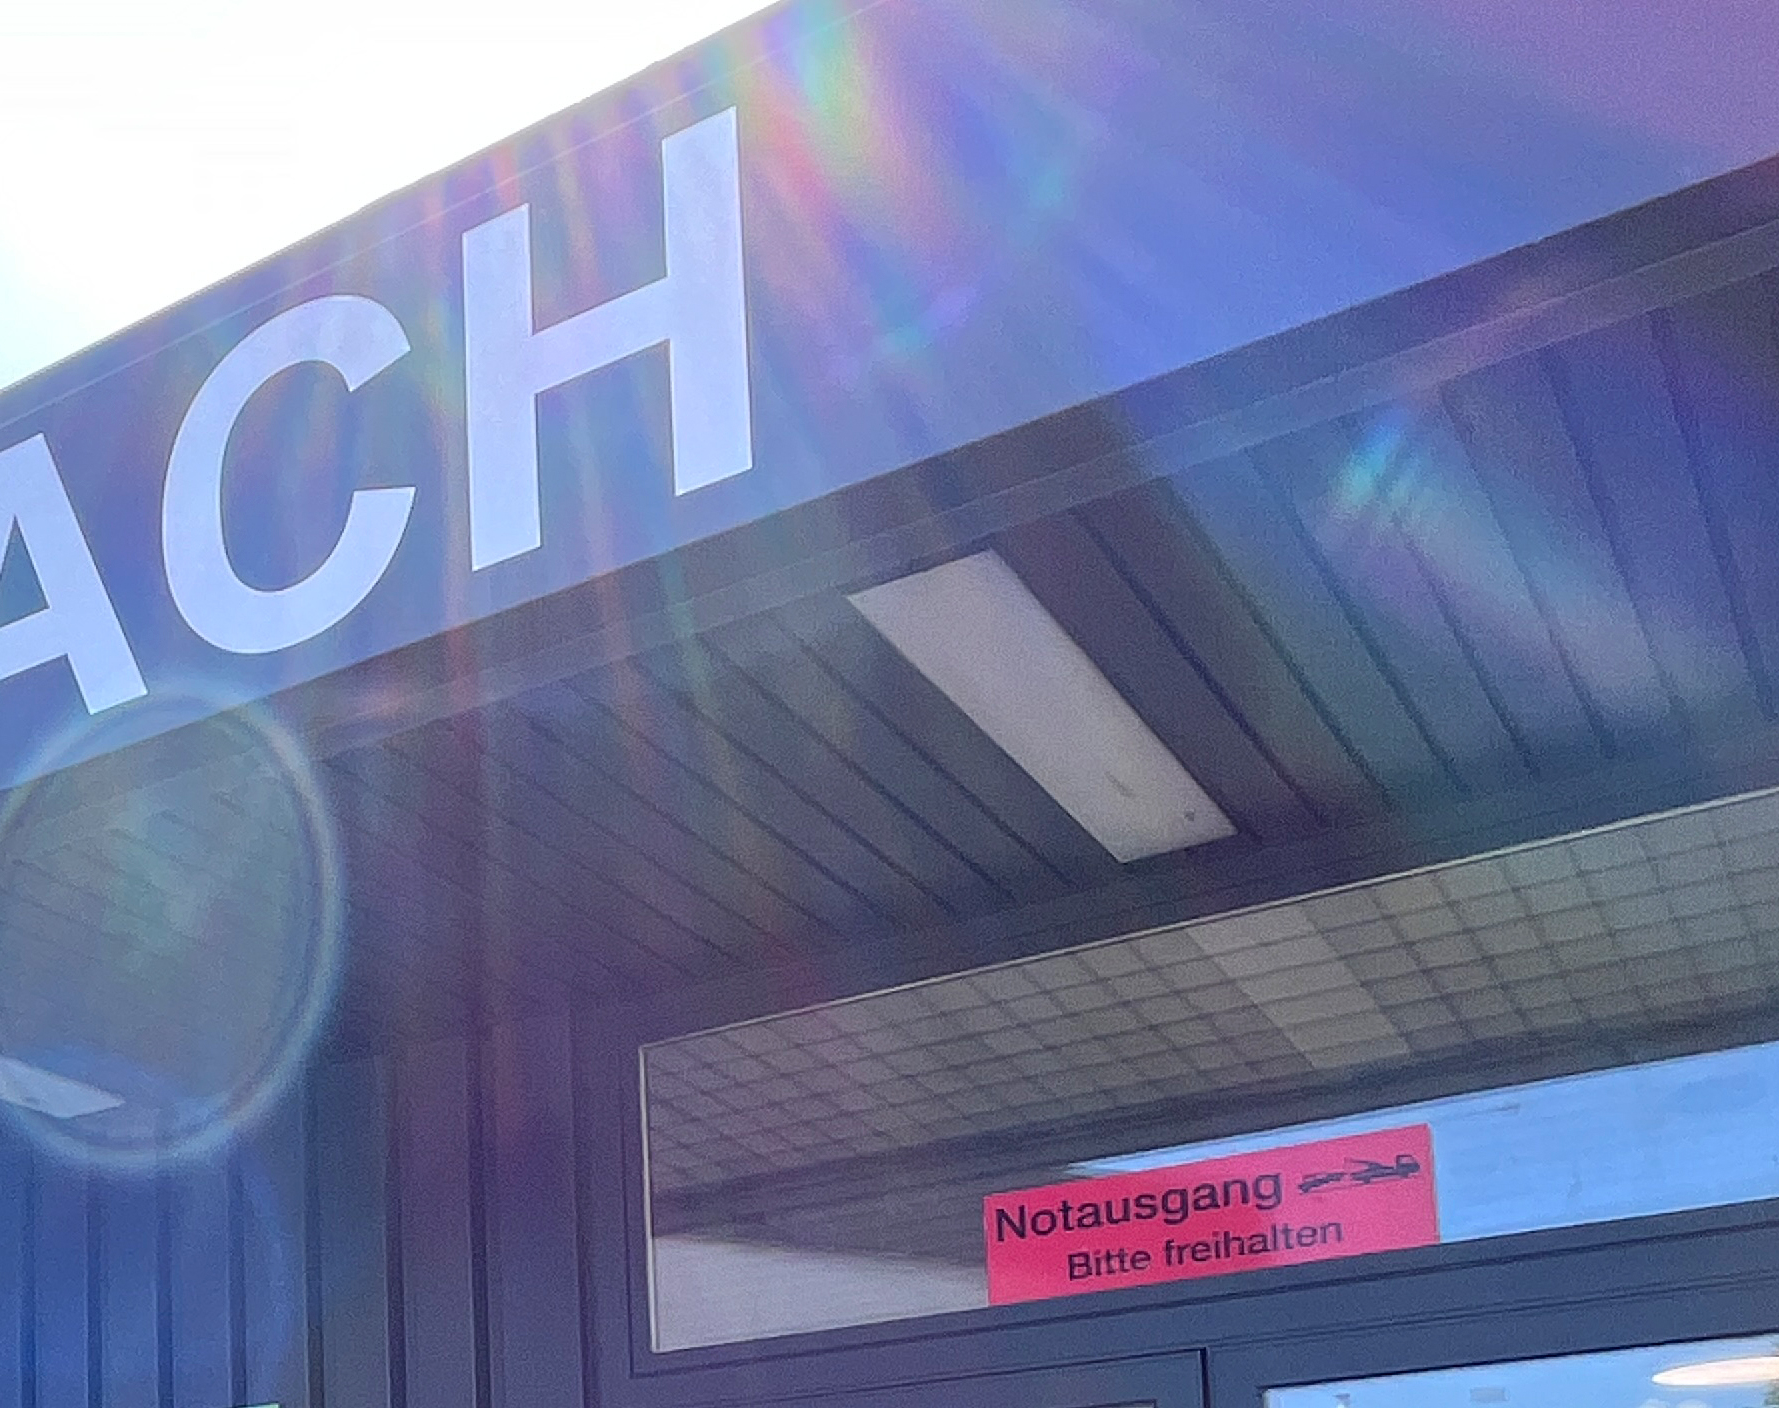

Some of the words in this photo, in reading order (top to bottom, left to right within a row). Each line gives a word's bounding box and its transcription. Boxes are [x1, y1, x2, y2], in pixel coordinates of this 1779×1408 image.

[996, 1172, 1282, 1242] Notausgang
[1068, 1248, 1151, 1282] Bitte
[1165, 1220, 1343, 1268] freihalten
